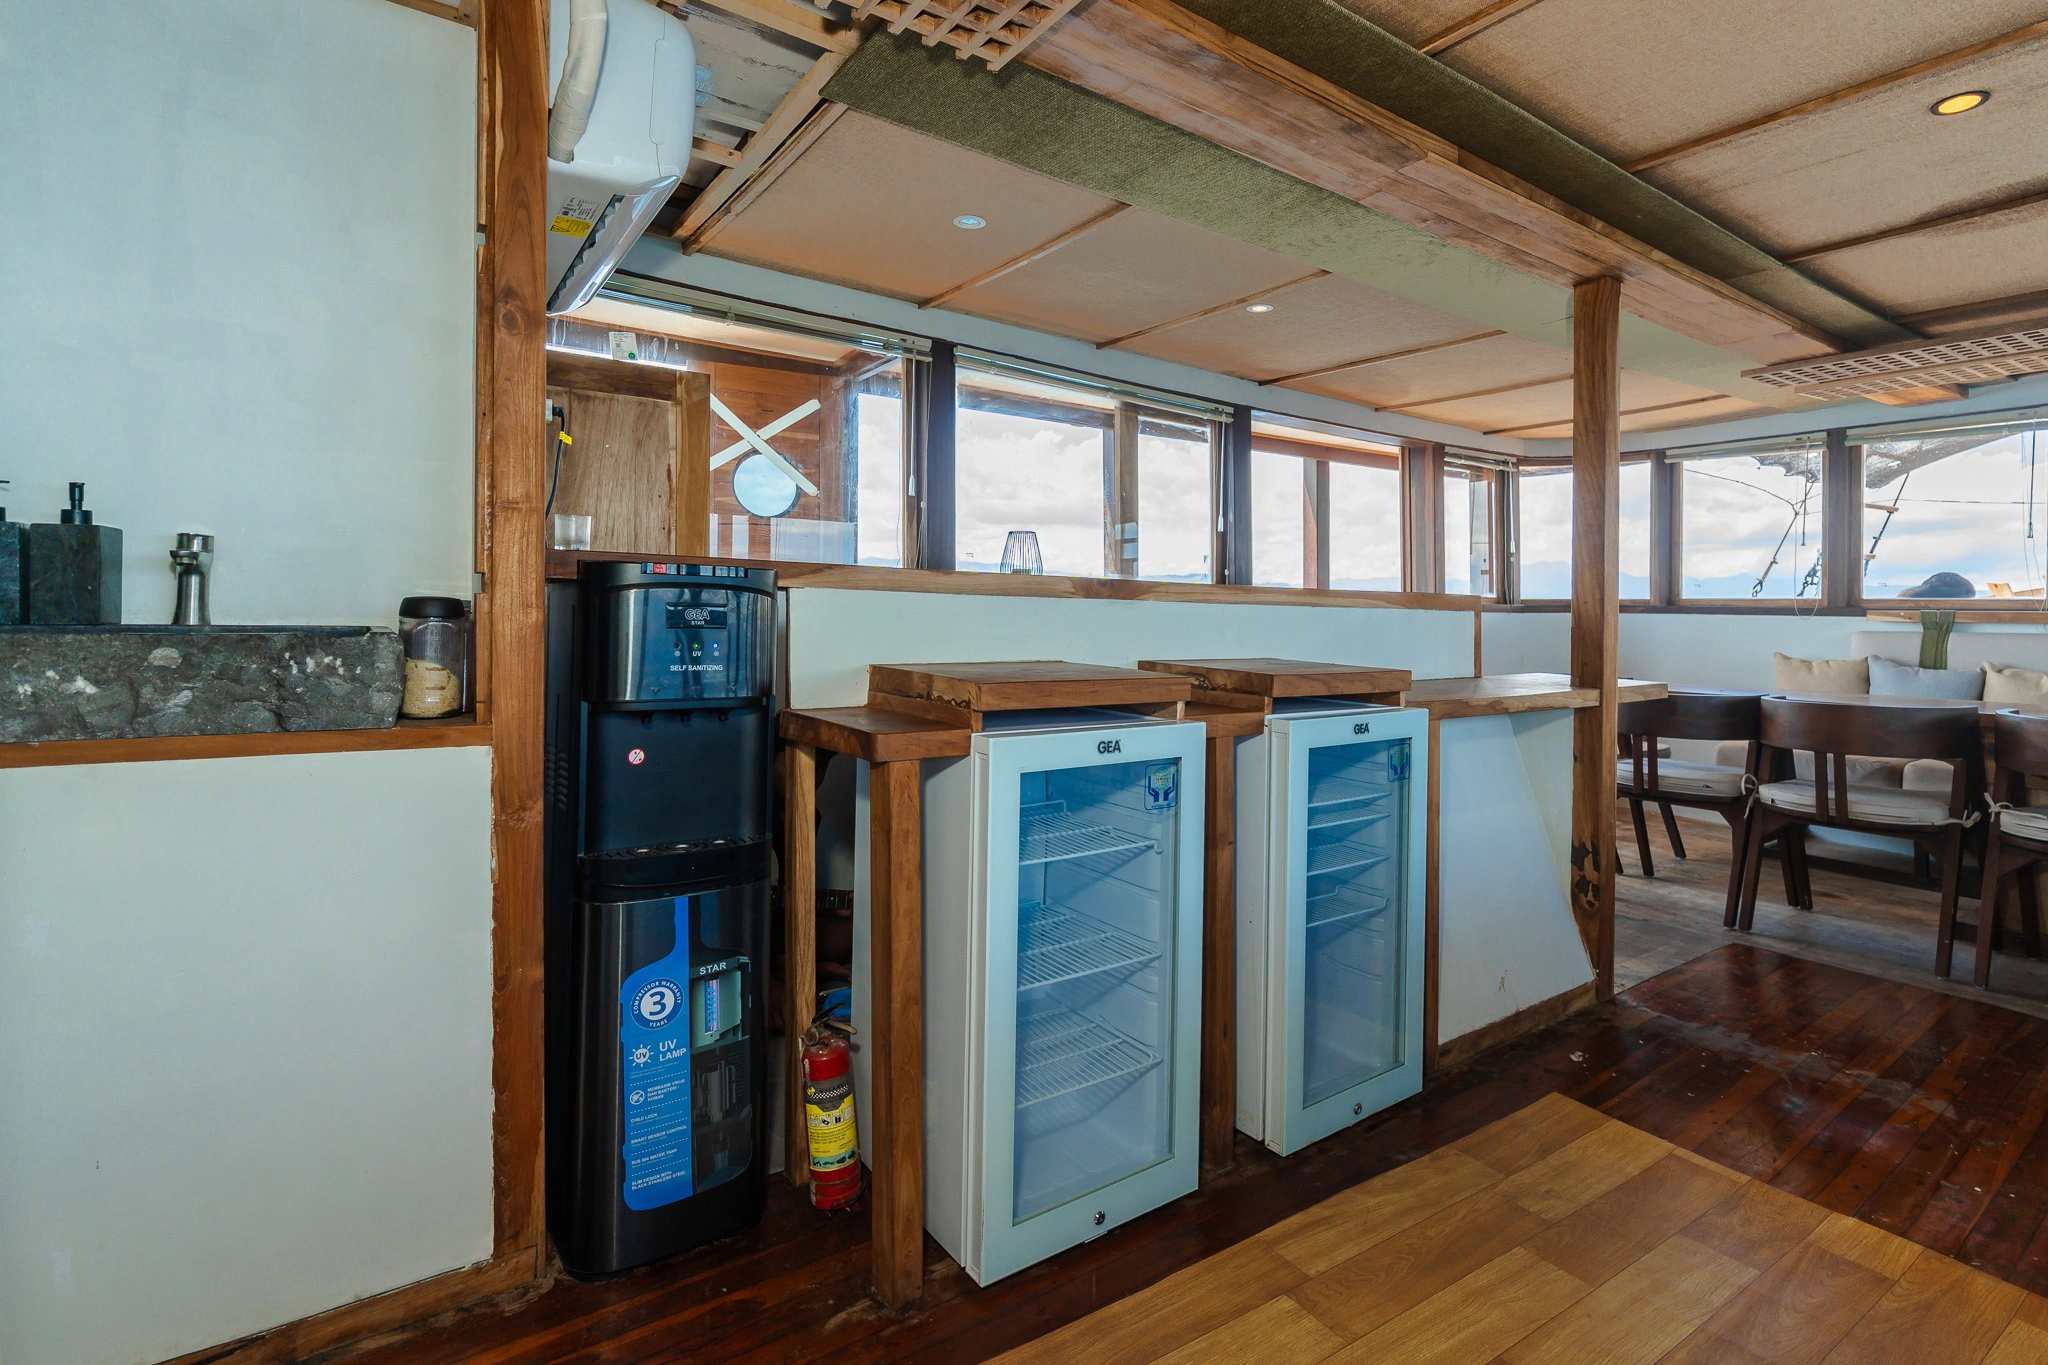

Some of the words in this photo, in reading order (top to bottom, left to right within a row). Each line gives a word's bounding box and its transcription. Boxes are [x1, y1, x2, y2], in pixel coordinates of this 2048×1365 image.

[685, 608, 710, 620] GEA
[1354, 722, 1370, 735] GEA
[1098, 739, 1122, 754] GEA
[700, 962, 727, 975] STAR
[649, 990, 667, 1016] 3
[660, 1038, 677, 1052] UV
[636, 1052, 648, 1060] UV
[660, 1048, 686, 1062] LAMP
